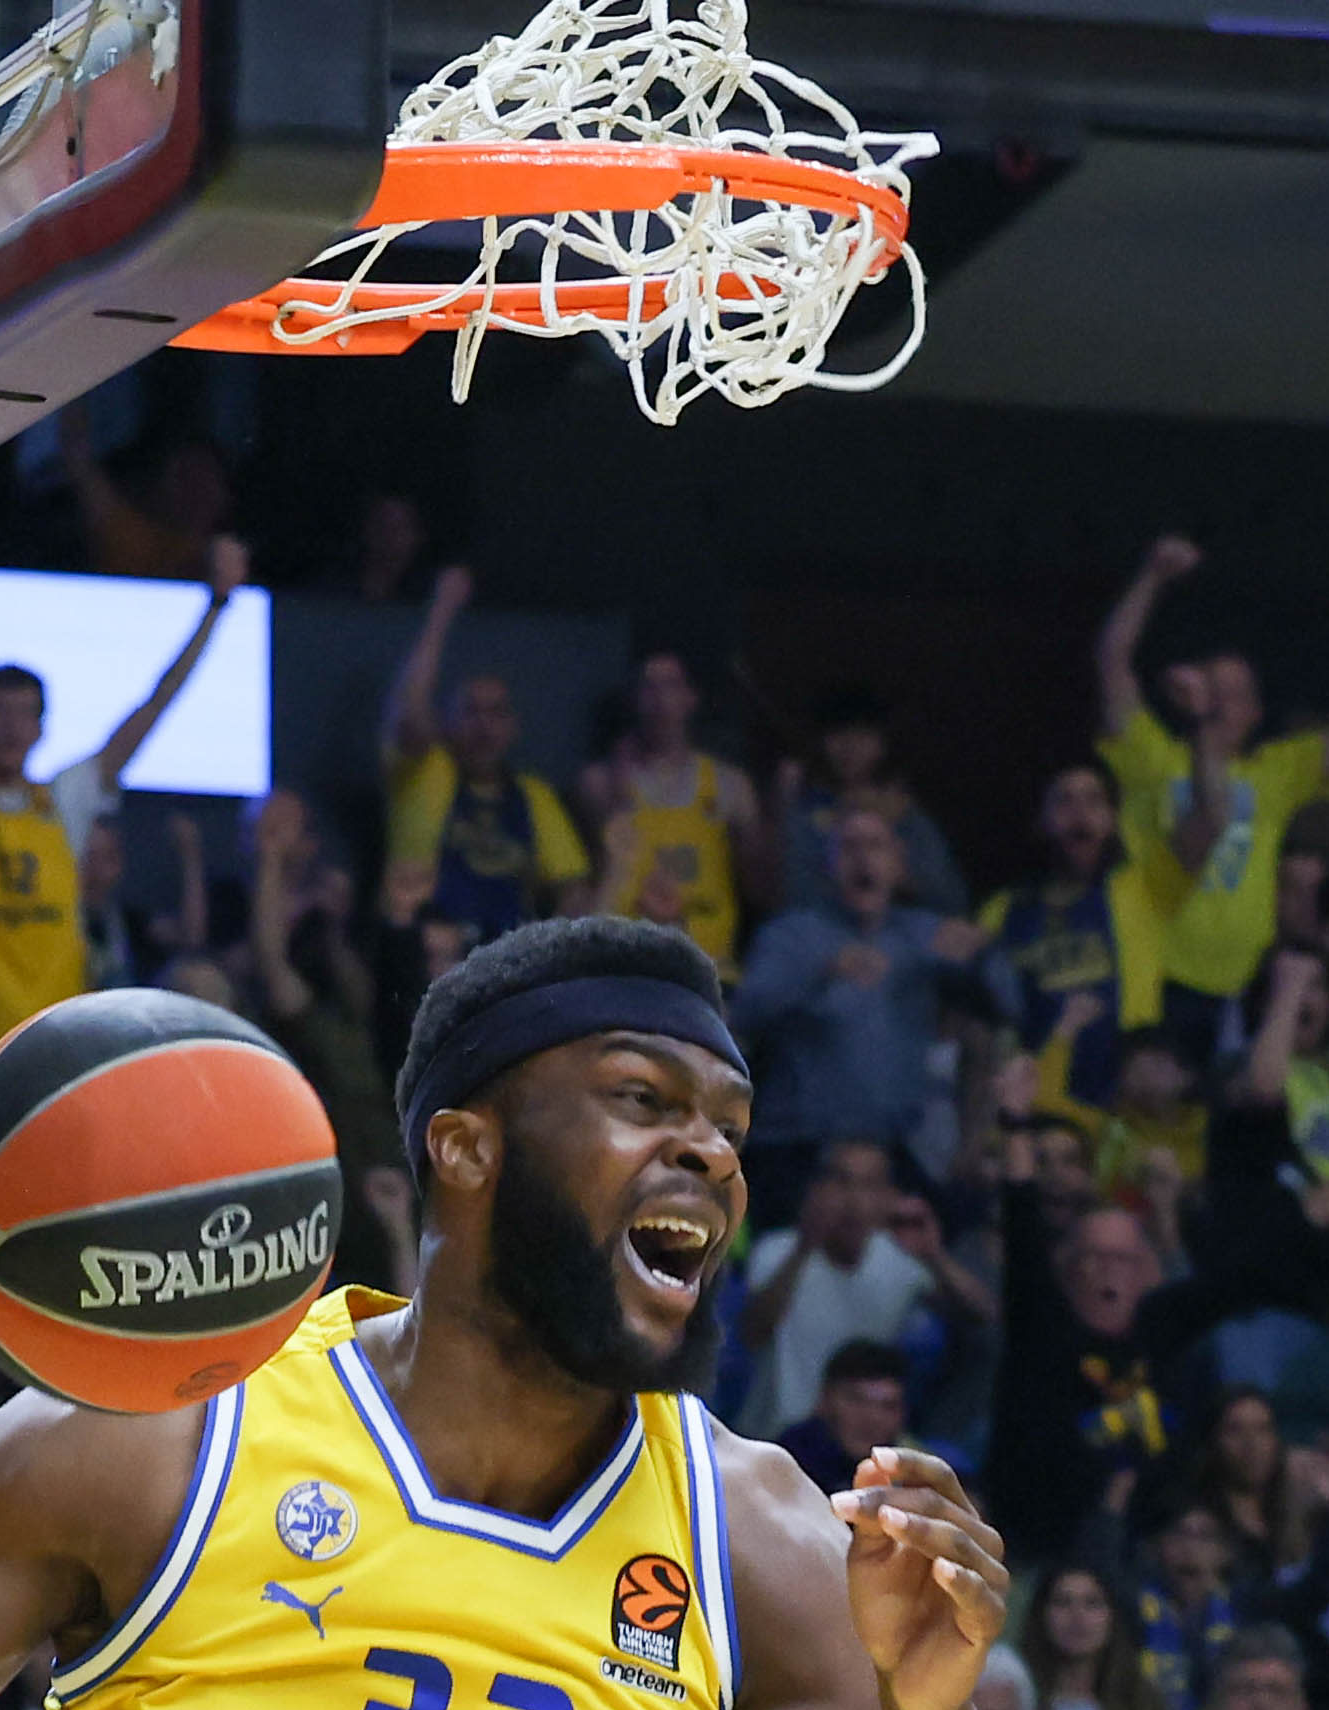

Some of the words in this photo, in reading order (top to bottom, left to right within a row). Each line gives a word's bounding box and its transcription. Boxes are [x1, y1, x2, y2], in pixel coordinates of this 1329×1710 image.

[79, 1199, 329, 1309] SPALDING
[617, 1621, 674, 1649] TURKISH
[601, 1659, 686, 1699] oneteam
